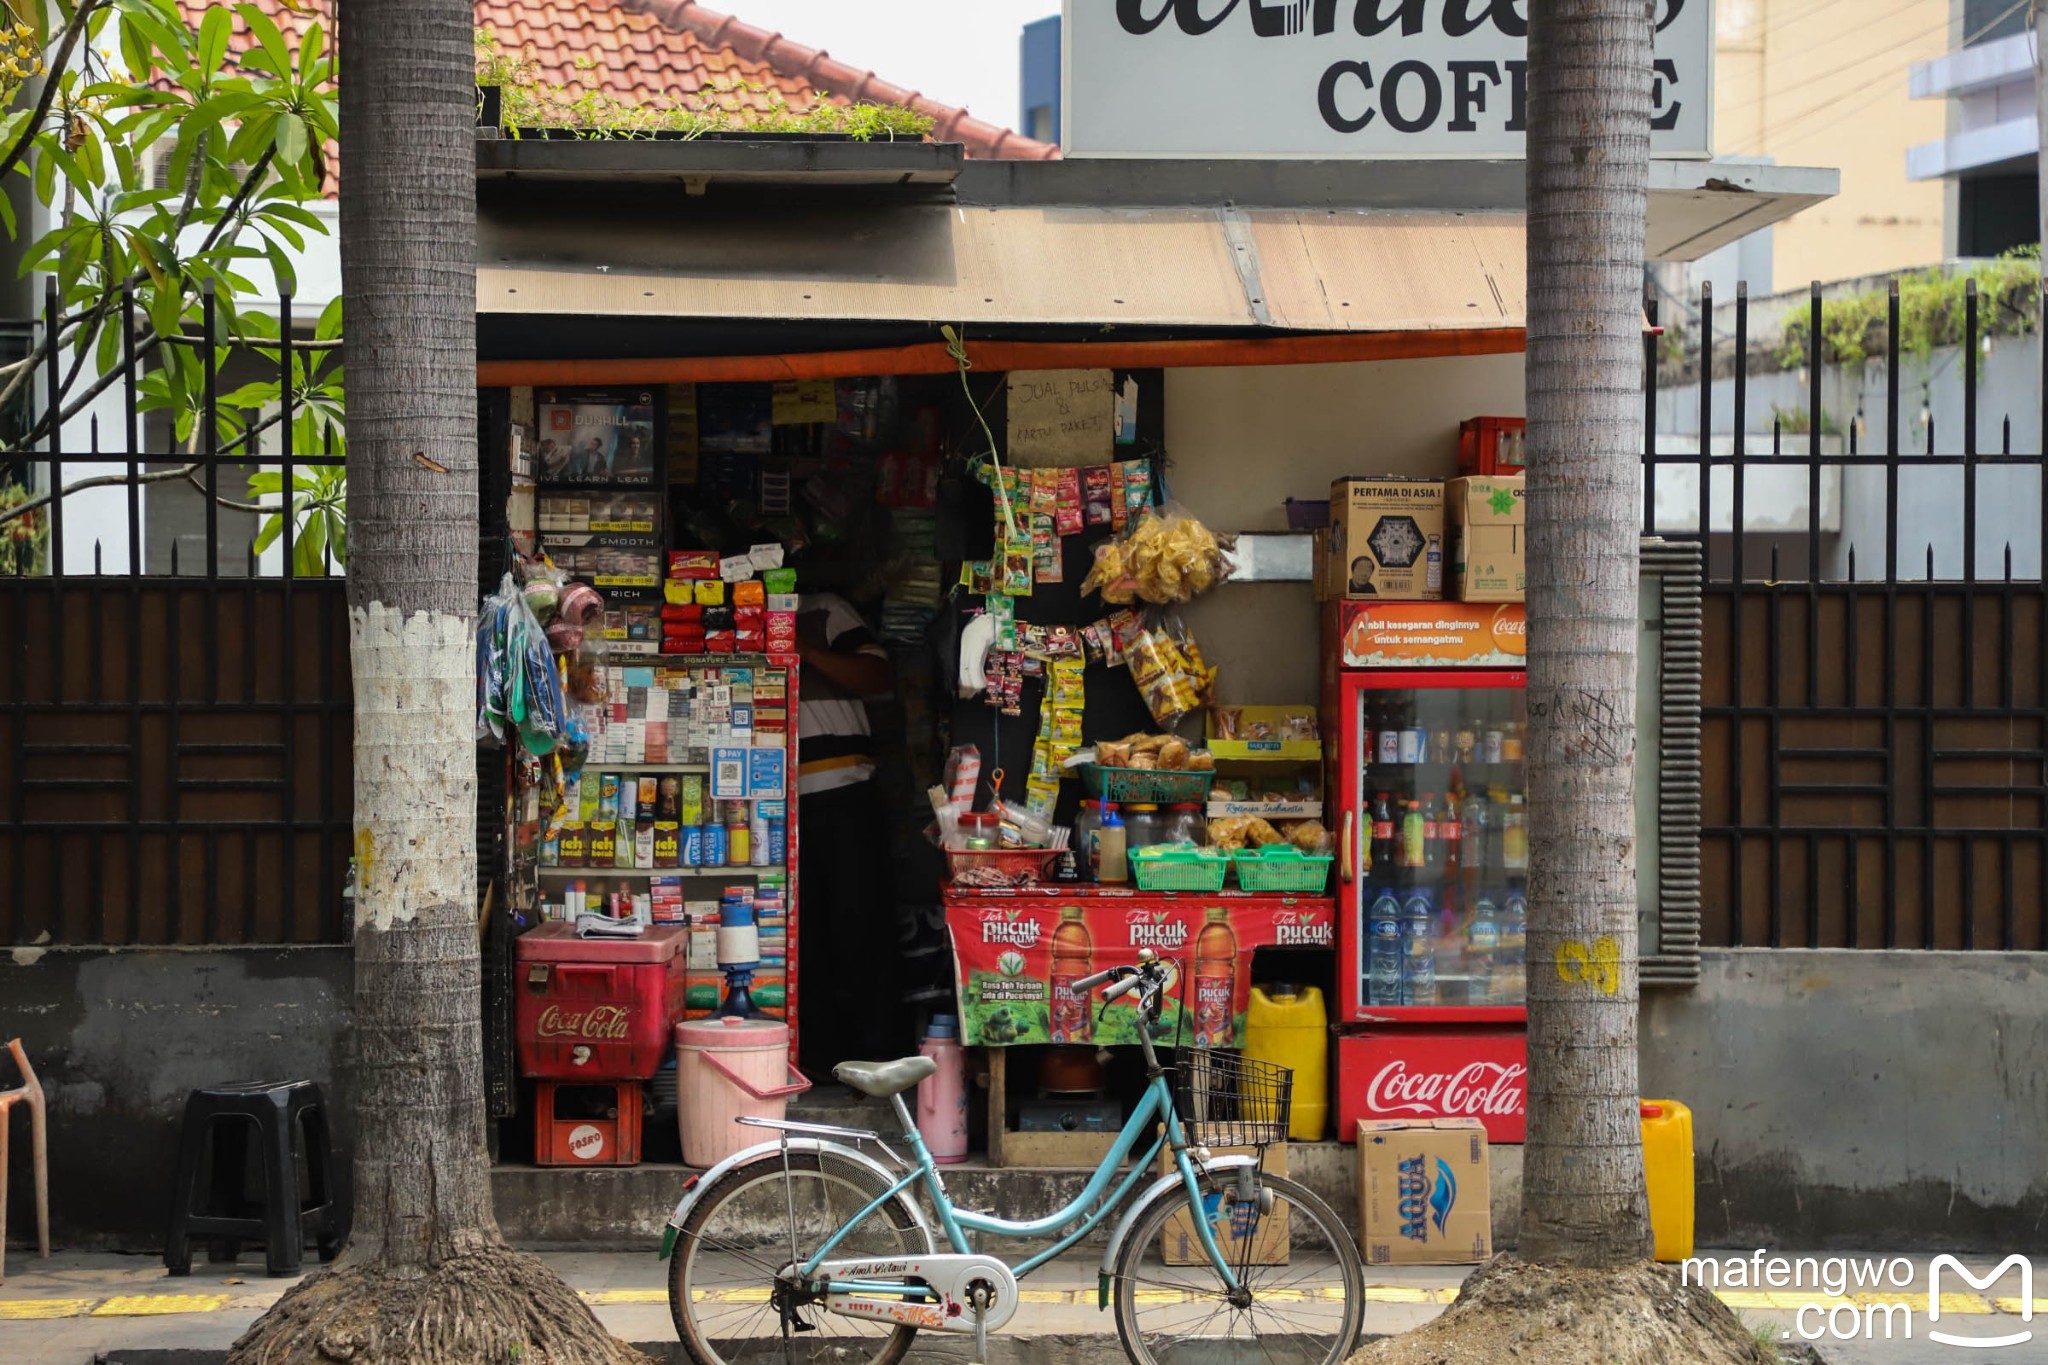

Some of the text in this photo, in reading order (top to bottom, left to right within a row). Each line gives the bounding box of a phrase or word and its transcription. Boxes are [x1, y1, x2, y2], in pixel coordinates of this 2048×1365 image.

[1020, 381, 1060, 403] JUAL
[1056, 397, 1071, 415] &
[575, 415, 630, 427] DUNHILL
[1017, 425, 1052, 443] KARTU
[568, 475, 609, 483] LEARN
[1353, 487, 1399, 497] PERTAMA
[1401, 488, 1411, 497] DI
[1413, 489, 1435, 498] ASIA
[600, 537, 654, 546] SMOOTH
[611, 590, 640, 598] RICH
[1387, 620, 1433, 631] kesegaran
[1435, 620, 1480, 631] dinginnya
[1374, 634, 1464, 645] untuk semangatmu
[560, 835, 583, 850] teh
[592, 836, 614, 850] teh
[655, 836, 678, 850] teh
[978, 907, 1003, 922] Teh
[1125, 909, 1151, 924] Teh
[1272, 910, 1297, 925] Teh
[982, 917, 1041, 943] pucuk
[1129, 919, 1188, 946] pucuk
[1276, 921, 1333, 945] pucuk
[993, 934, 1037, 946] HARUM
[1139, 937, 1182, 948] HARUM
[982, 982, 1043, 990] Rasa Teh Terbaik
[1005, 992, 1043, 1001] Pucuknya!
[1198, 986, 1231, 1002] pucuk
[537, 1004, 630, 1039] Coca-Cola
[1366, 1060, 1527, 1115] Coca-Cola
[569, 1132, 602, 1151] SOSRO
[1397, 1152, 1428, 1244] AQUA
[847, 1261, 909, 1277] Anak Betawi
